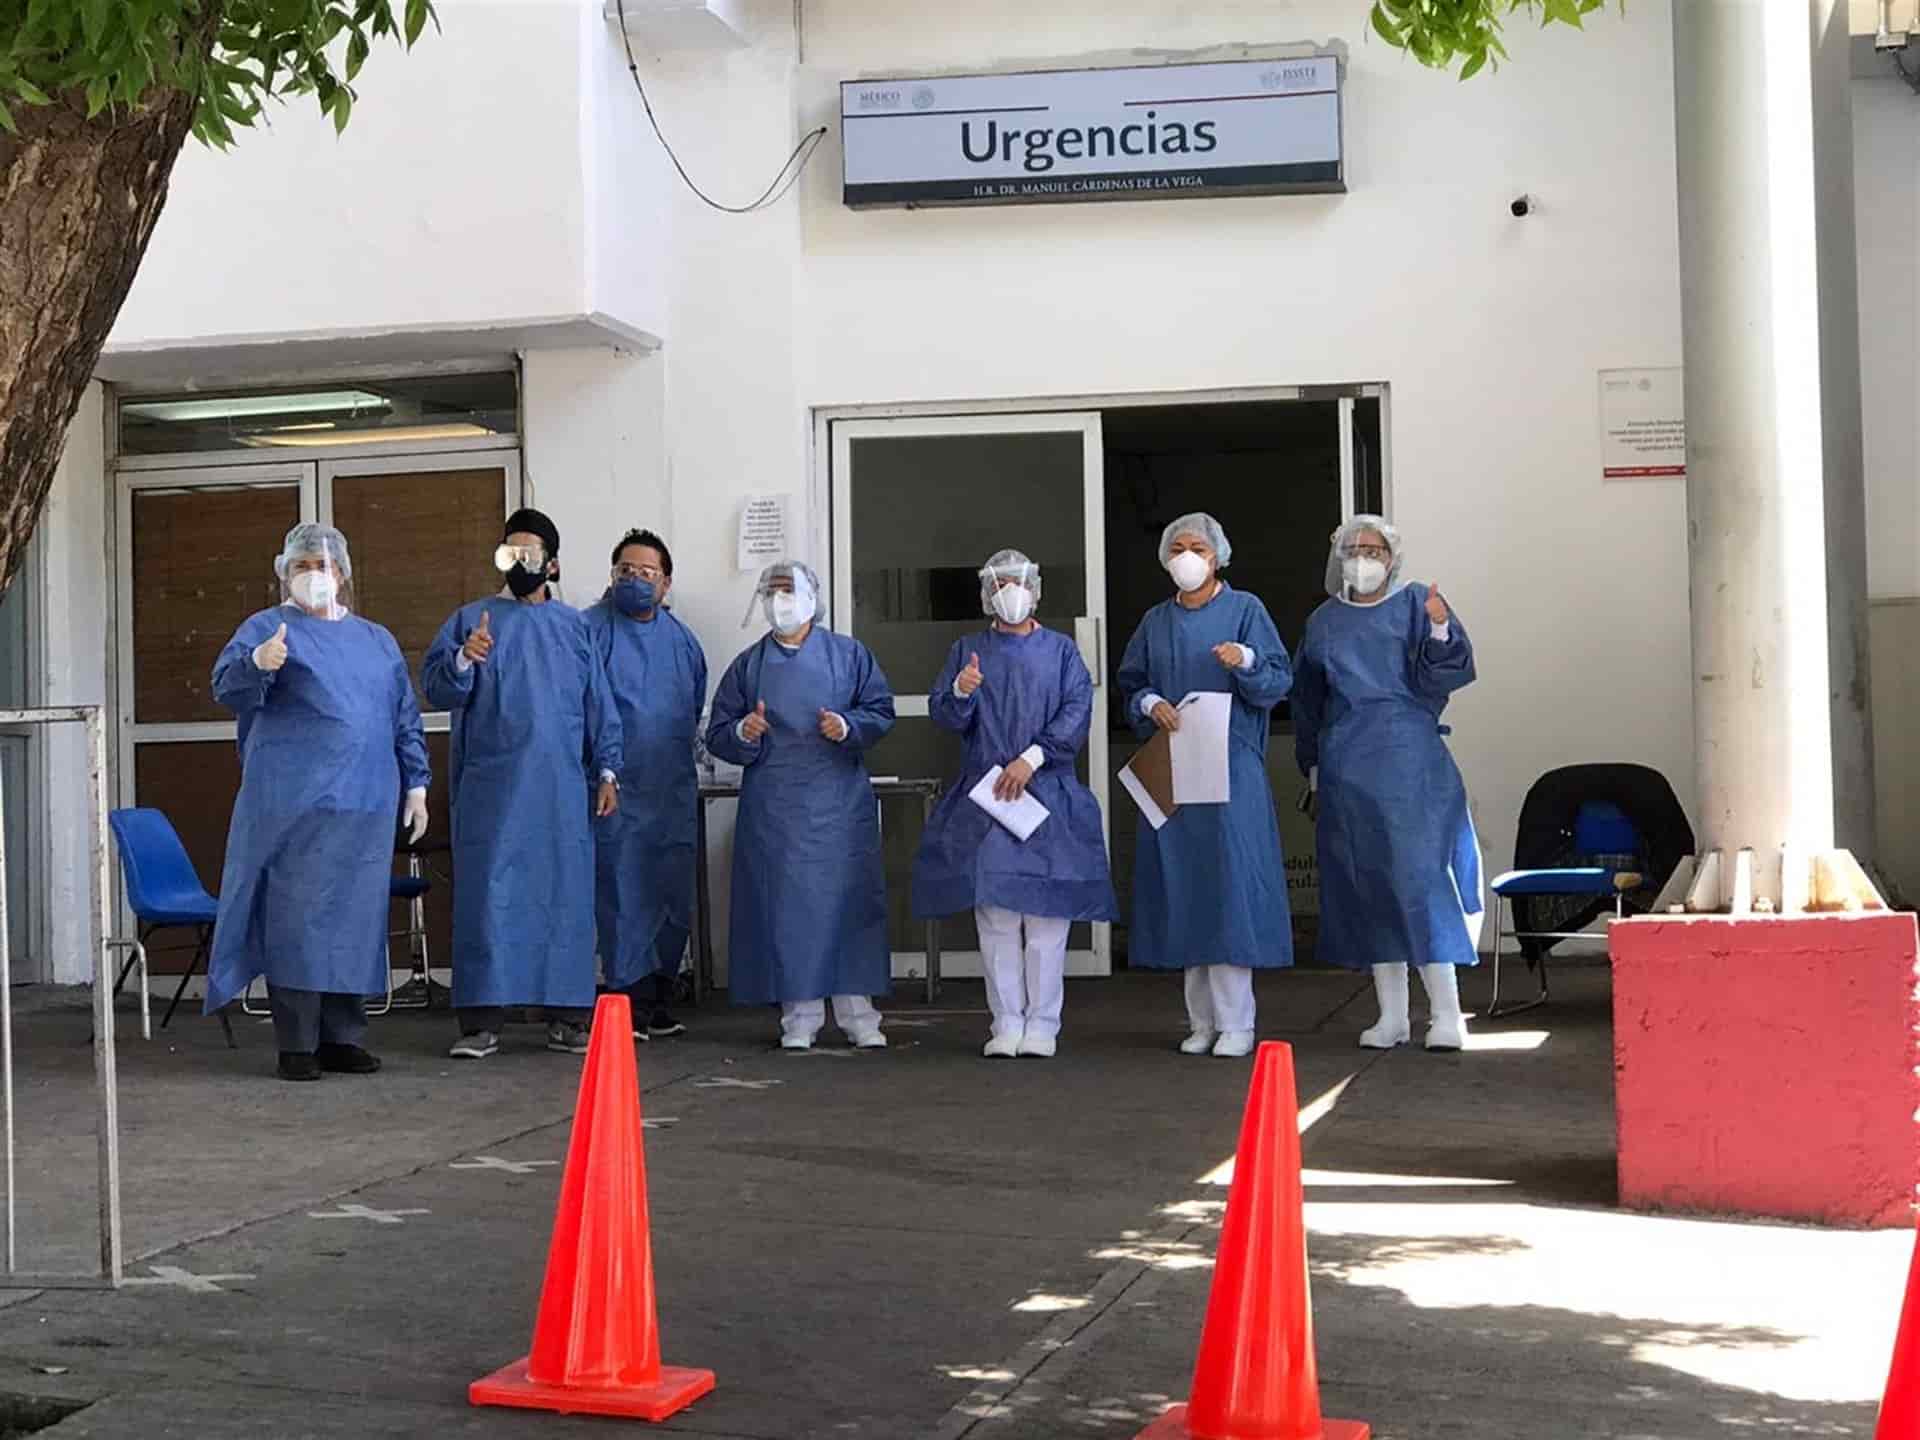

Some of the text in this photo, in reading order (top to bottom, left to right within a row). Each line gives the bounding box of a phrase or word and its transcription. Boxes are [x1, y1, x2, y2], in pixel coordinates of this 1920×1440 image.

[961, 111, 1217, 172] Urgencias
[1022, 183, 1070, 193] MANUEL
[1137, 178, 1152, 189] DE
[1155, 177, 1169, 188] LA
[1172, 175, 1203, 187] VEGA
